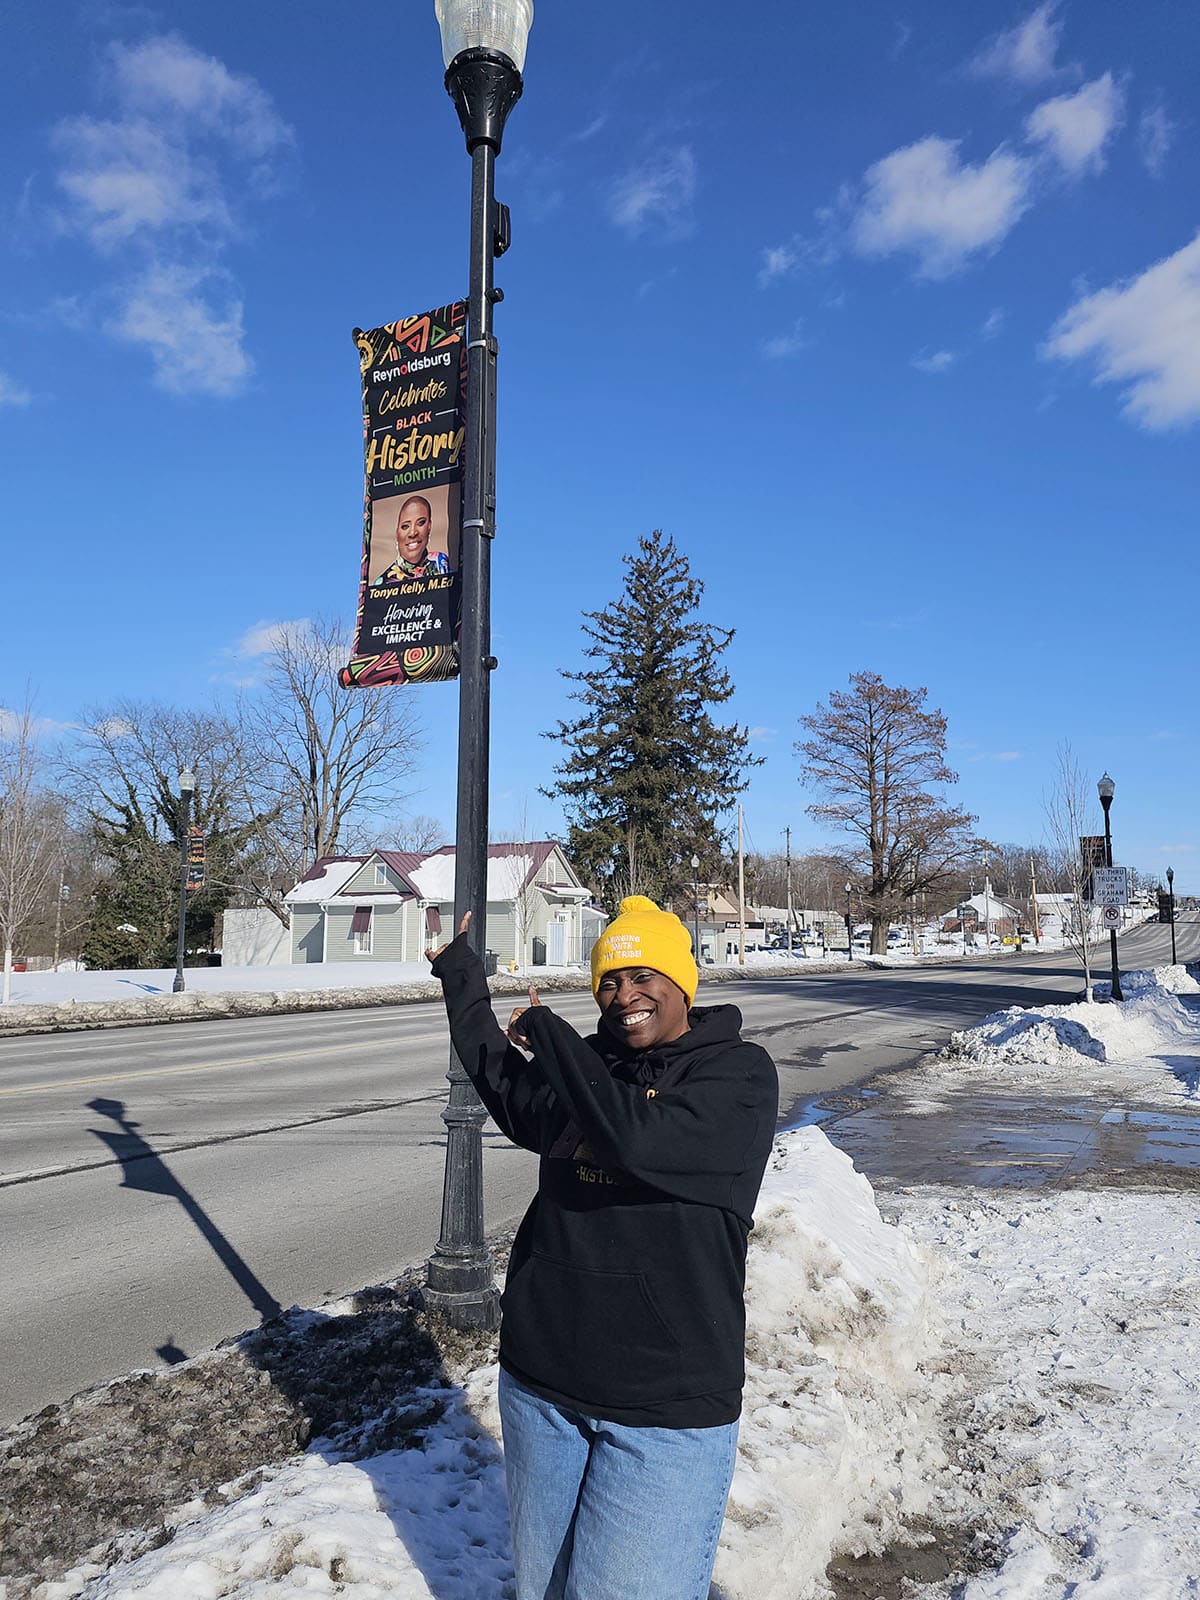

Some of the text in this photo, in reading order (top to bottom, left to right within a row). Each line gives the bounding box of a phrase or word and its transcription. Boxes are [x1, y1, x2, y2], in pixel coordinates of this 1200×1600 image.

[373, 352, 451, 383] Reynoldsburg
[378, 378, 448, 415] Celebrates
[396, 411, 432, 431] BLACK
[366, 427, 465, 474] History
[393, 466, 436, 486] MONTH
[369, 587, 399, 600] Tonya
[400, 581, 425, 595] Kelly,
[382, 602, 434, 624] Honoring
[372, 620, 442, 636] EXCELLENCE &
[385, 631, 425, 645] IMPACT
